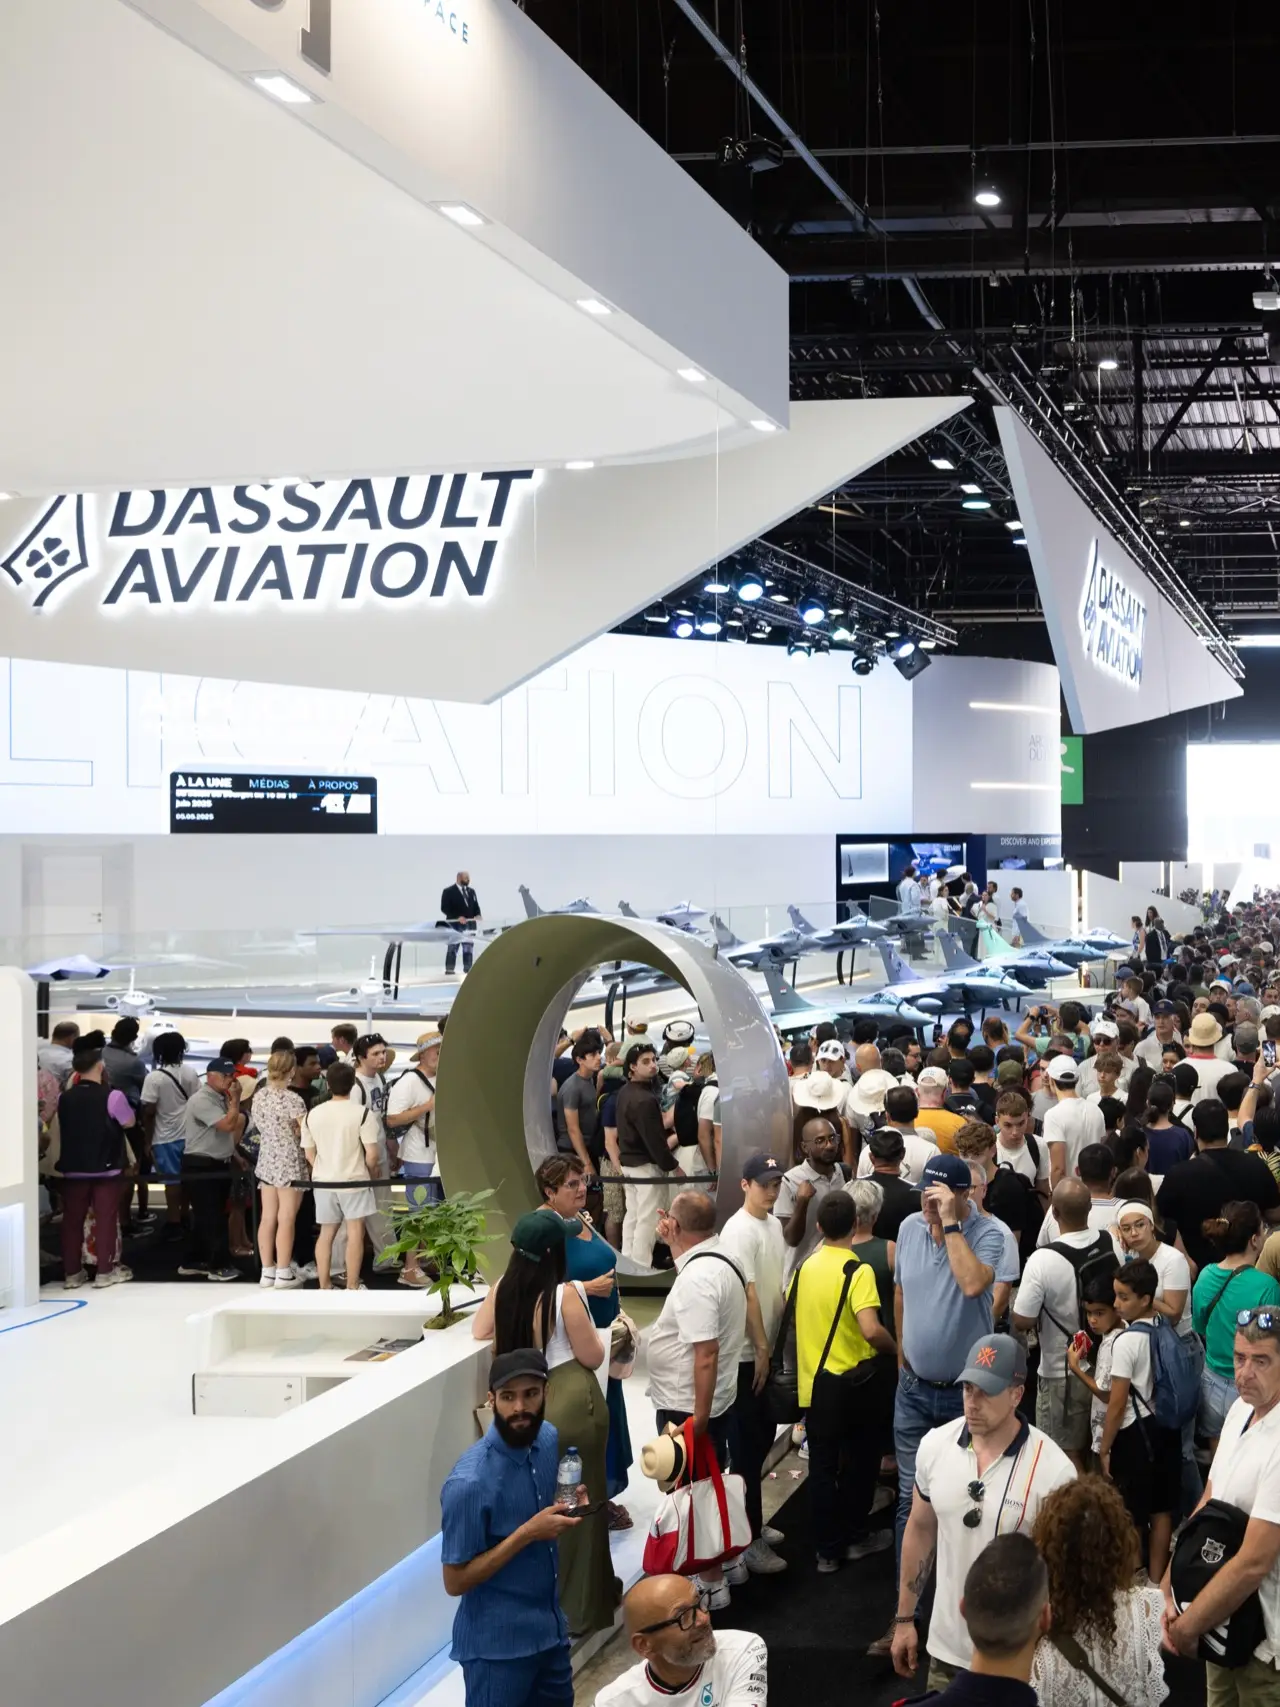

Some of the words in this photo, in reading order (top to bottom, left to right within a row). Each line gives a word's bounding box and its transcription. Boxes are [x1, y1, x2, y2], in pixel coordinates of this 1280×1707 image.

[108, 468, 535, 538] DASSAULT
[102, 540, 498, 605] AVIATION
[187, 776, 205, 787] LA
[206, 777, 233, 788] UNE
[248, 777, 291, 789] MÉDIAS
[318, 780, 360, 791] PROPOS
[1000, 837, 1028, 846] DISCOVER
